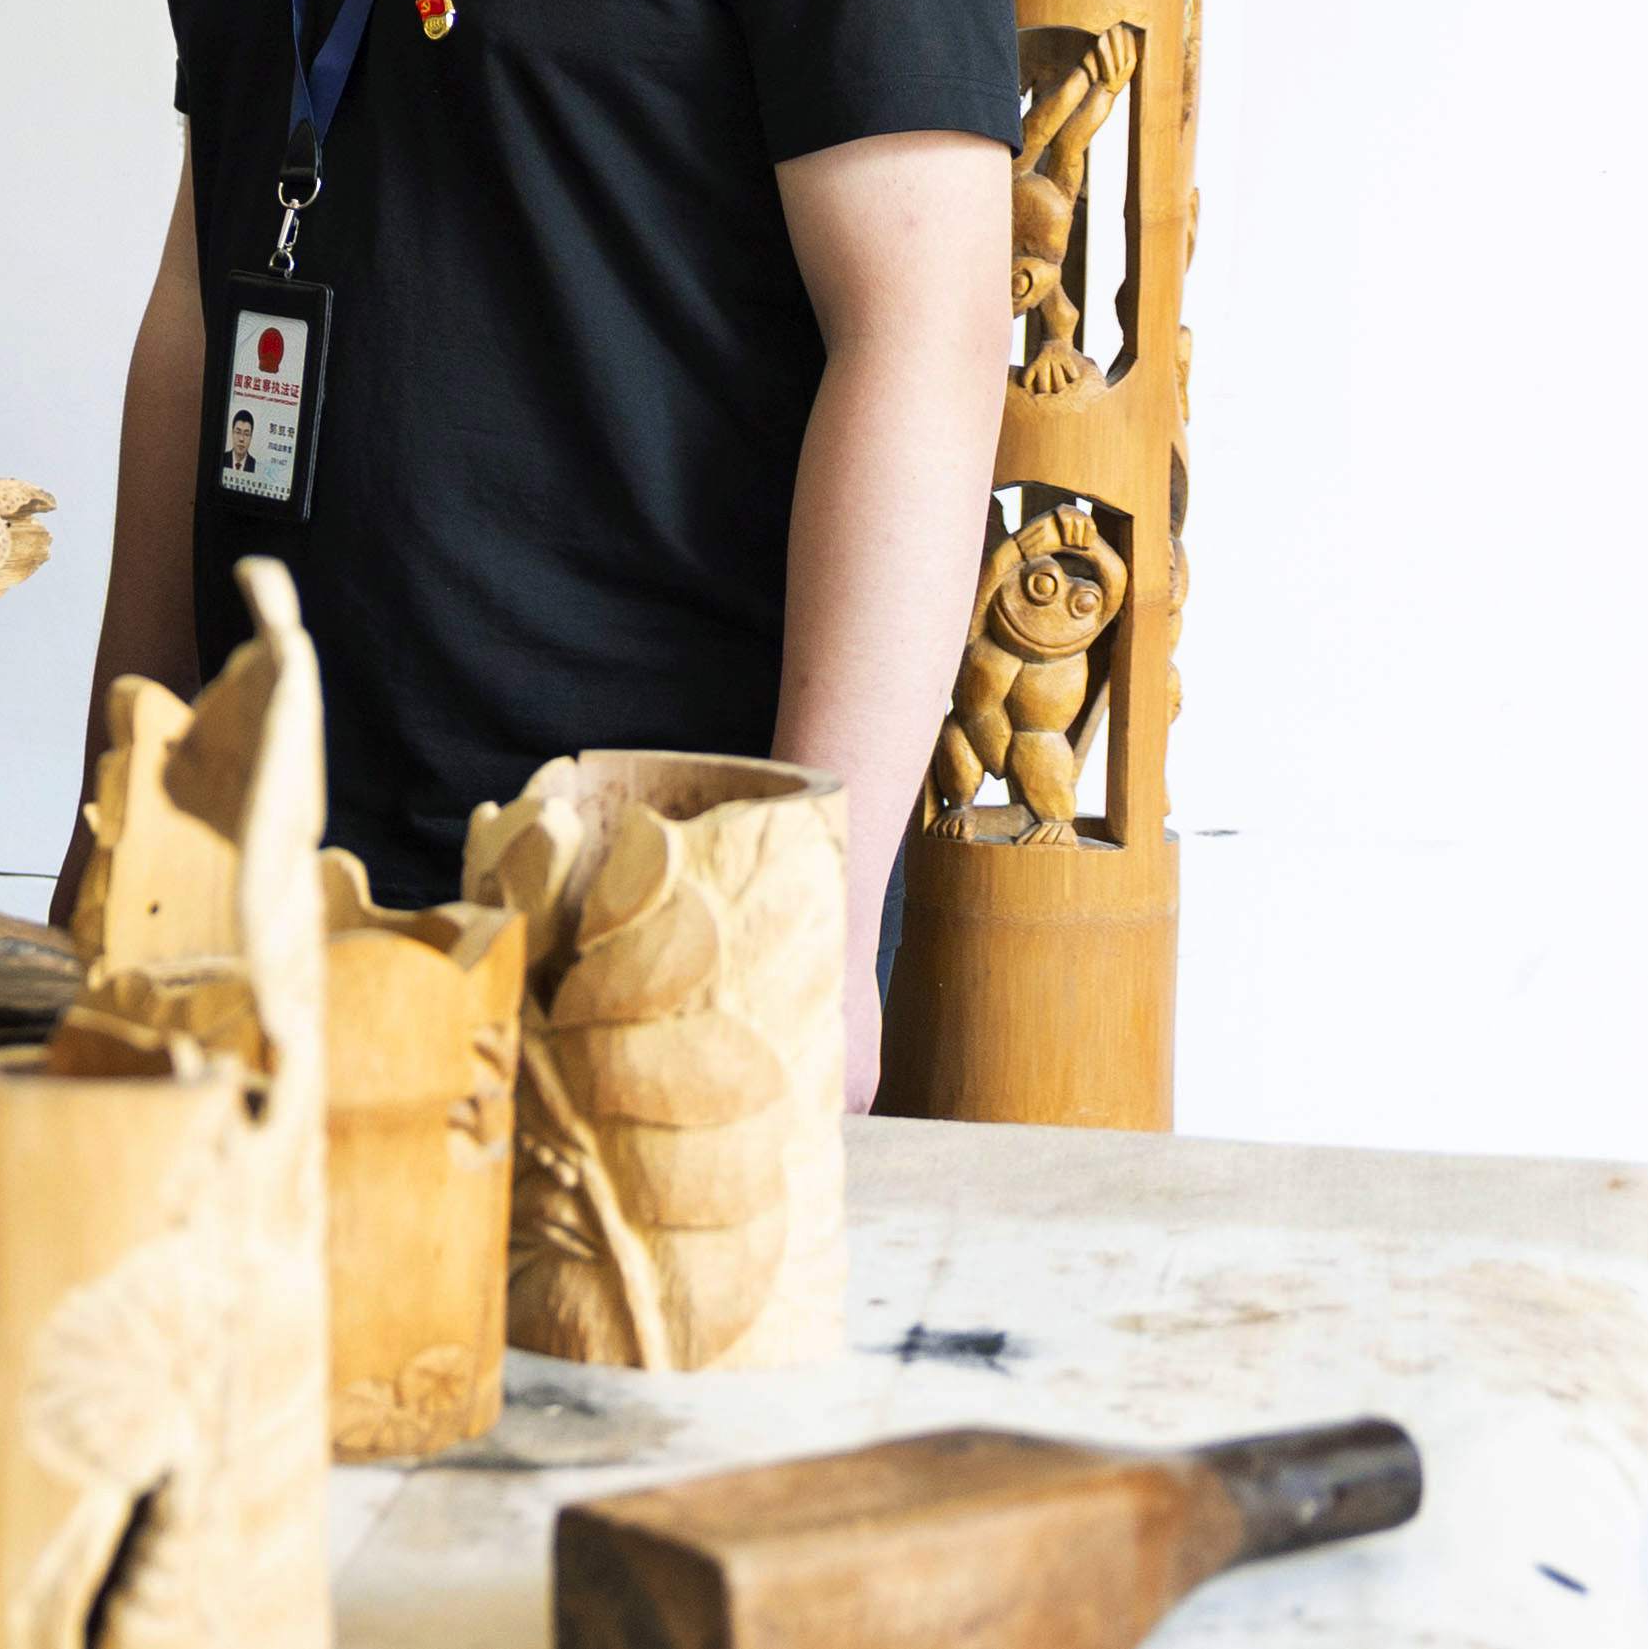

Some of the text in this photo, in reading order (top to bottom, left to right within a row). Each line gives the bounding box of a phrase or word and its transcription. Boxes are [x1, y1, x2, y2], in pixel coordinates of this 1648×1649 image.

[233, 373, 300, 399] 国家监察执法证
